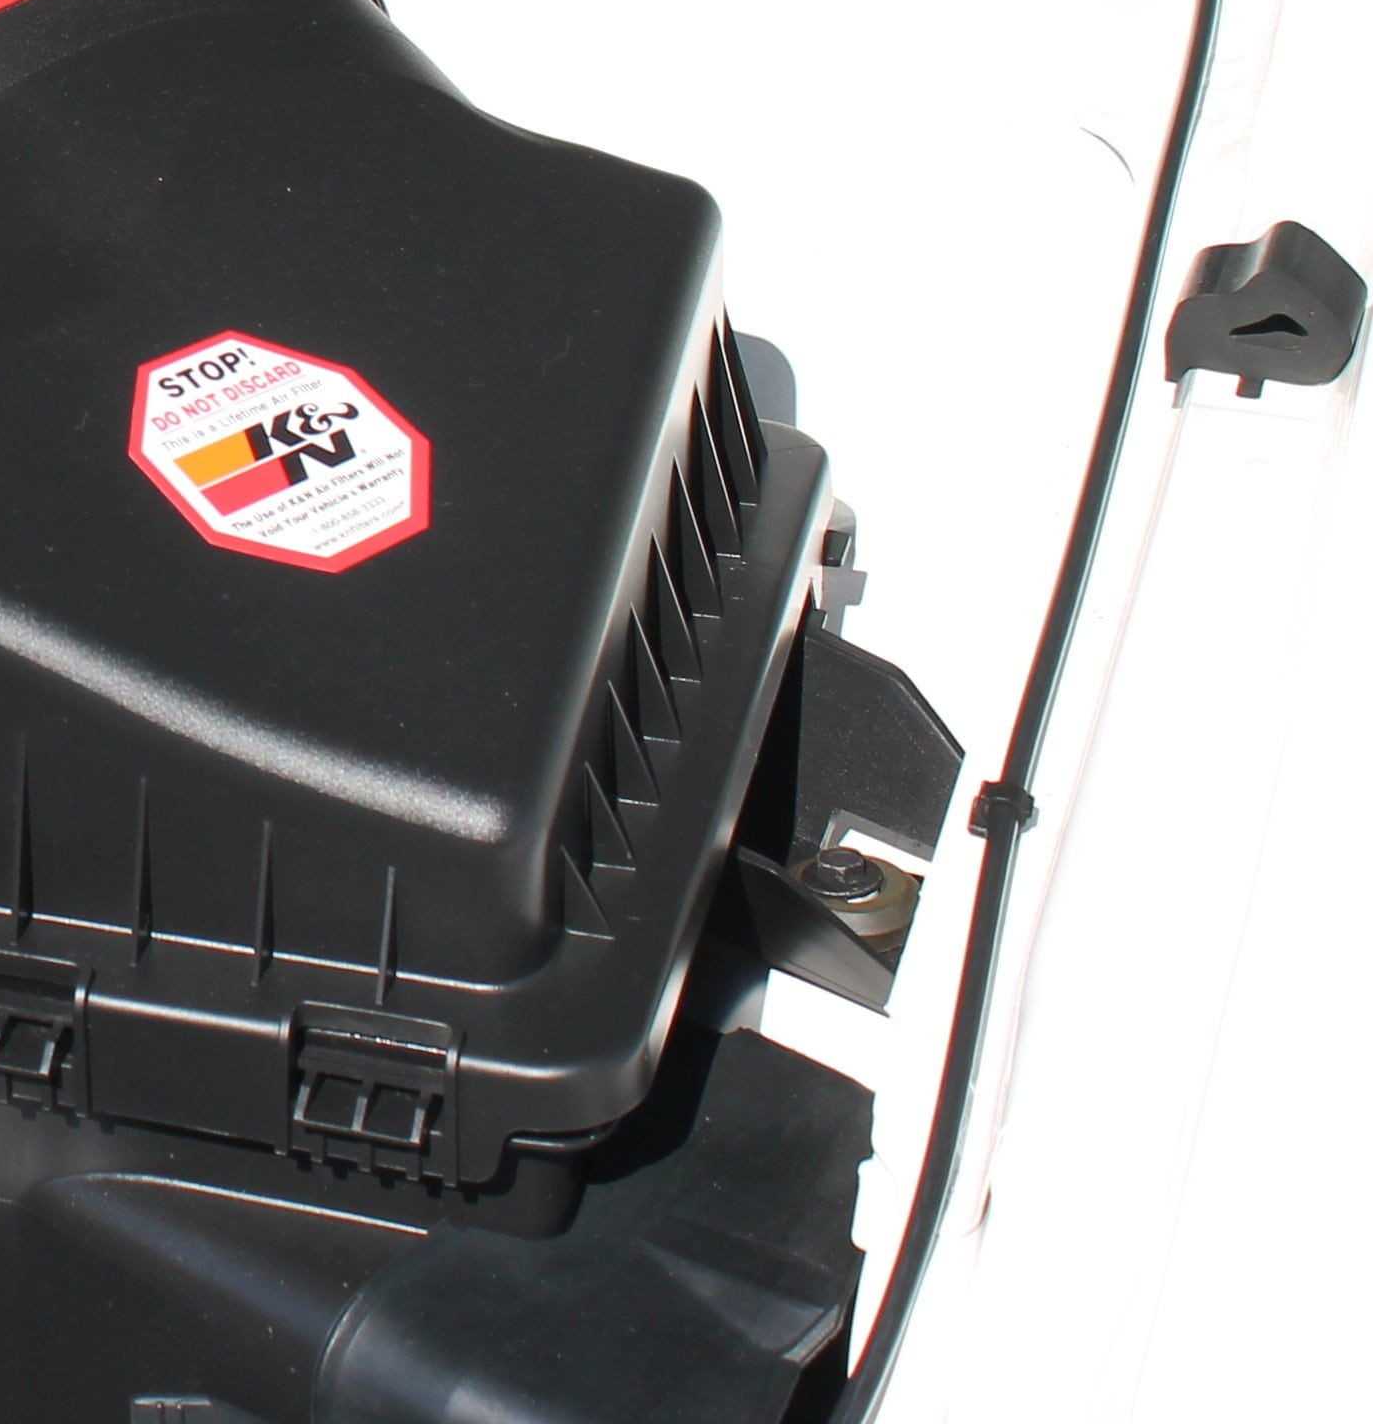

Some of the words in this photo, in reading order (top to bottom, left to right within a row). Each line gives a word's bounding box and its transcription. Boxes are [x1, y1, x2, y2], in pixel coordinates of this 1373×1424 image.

[150, 410, 182, 433] DO
[180, 392, 221, 420] NOT
[220, 361, 303, 402] DISCARD
[157, 347, 257, 398] STOP!
[160, 432, 191, 453] This
[193, 428, 207, 440] is
[219, 401, 269, 429] Lifetime
[270, 392, 290, 407] Air
[290, 378, 324, 398] Filter
[245, 402, 359, 487] K&N
[231, 518, 253, 533] The
[253, 509, 276, 524] Use
[288, 490, 314, 508] K&N
[315, 483, 330, 496] Air
[330, 468, 365, 488] Filters
[364, 456, 386, 472] Will
[385, 448, 406, 463] Not
[258, 522, 284, 539] Void
[357, 467, 406, 494] Warranty
